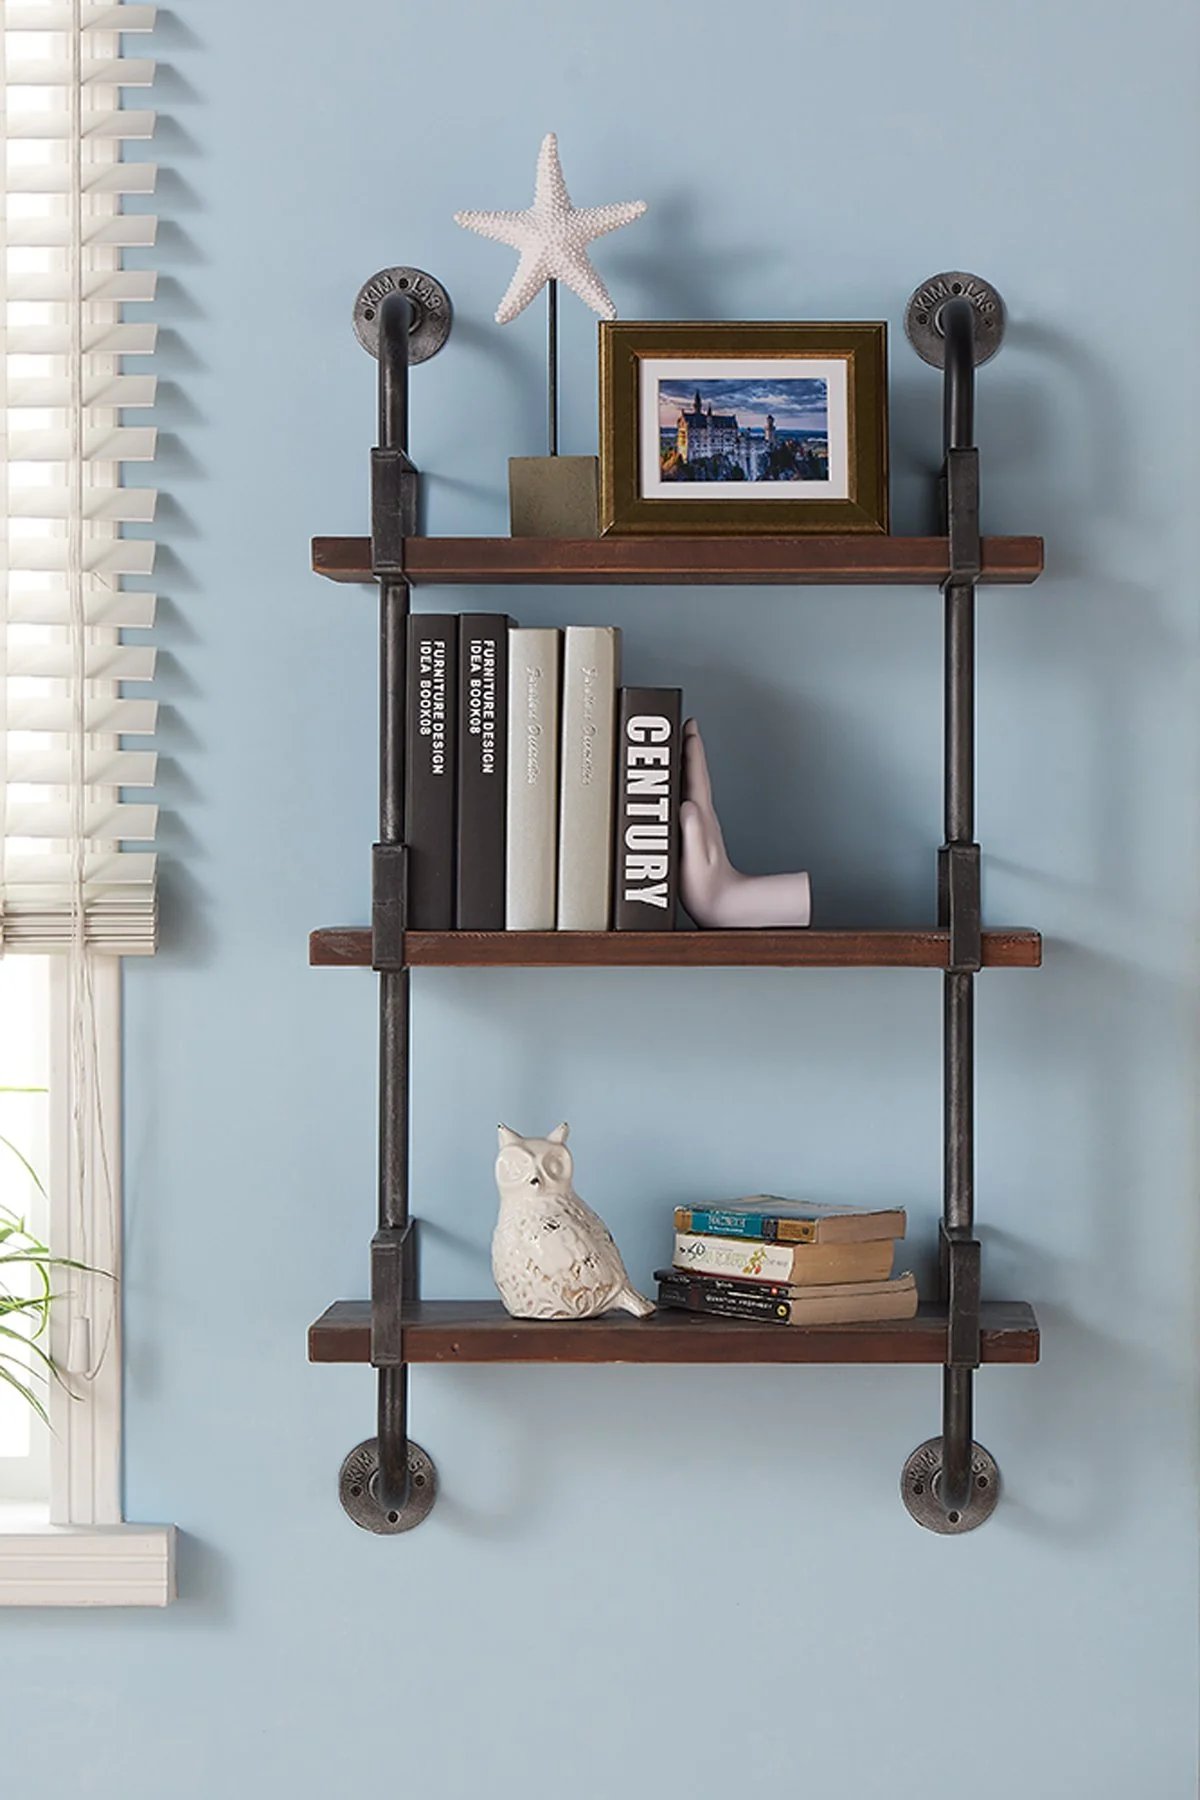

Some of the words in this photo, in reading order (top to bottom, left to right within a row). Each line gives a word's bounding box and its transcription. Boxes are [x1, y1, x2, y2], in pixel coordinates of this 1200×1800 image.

[420, 640, 432, 673] IDEA
[433, 640, 445, 720] FURNITURE
[470, 640, 482, 672] IDEA
[483, 640, 495, 719] FURNITURE
[470, 679, 482, 734] BOOK08
[432, 723, 444, 775] DESIGN
[482, 722, 494, 774] DESIGN
[625, 715, 671, 909] CENTURY
